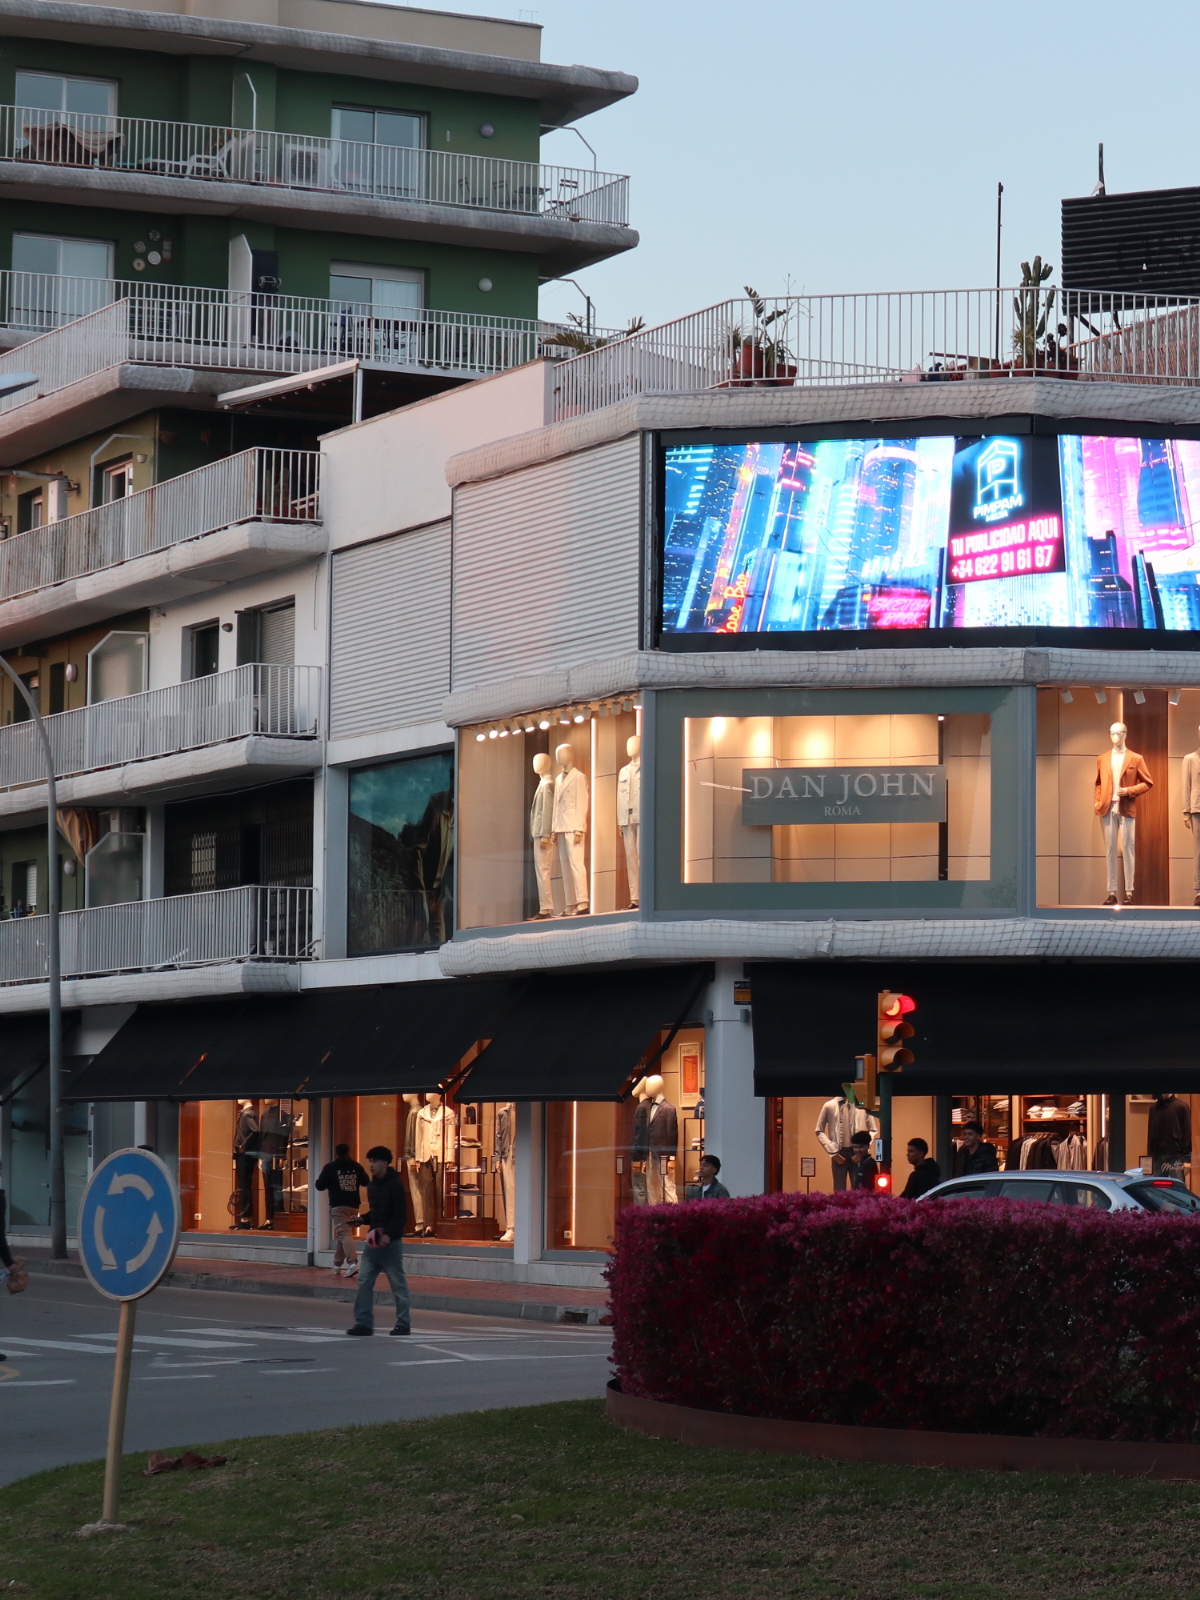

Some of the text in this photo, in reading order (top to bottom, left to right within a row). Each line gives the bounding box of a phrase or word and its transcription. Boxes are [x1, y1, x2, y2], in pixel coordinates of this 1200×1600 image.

[973, 494, 1023, 519] PIMPAM
[985, 510, 1009, 522] MEDIA
[951, 516, 1059, 557] TU PUBLICIDAD AQUI
[951, 558, 974, 578] +34
[974, 554, 999, 576] 622
[1001, 551, 1015, 572] 91
[1017, 547, 1032, 570] 61
[1035, 545, 1054, 567] 67
[750, 773, 936, 805] DAN JOHN
[824, 806, 861, 816] ROMA
